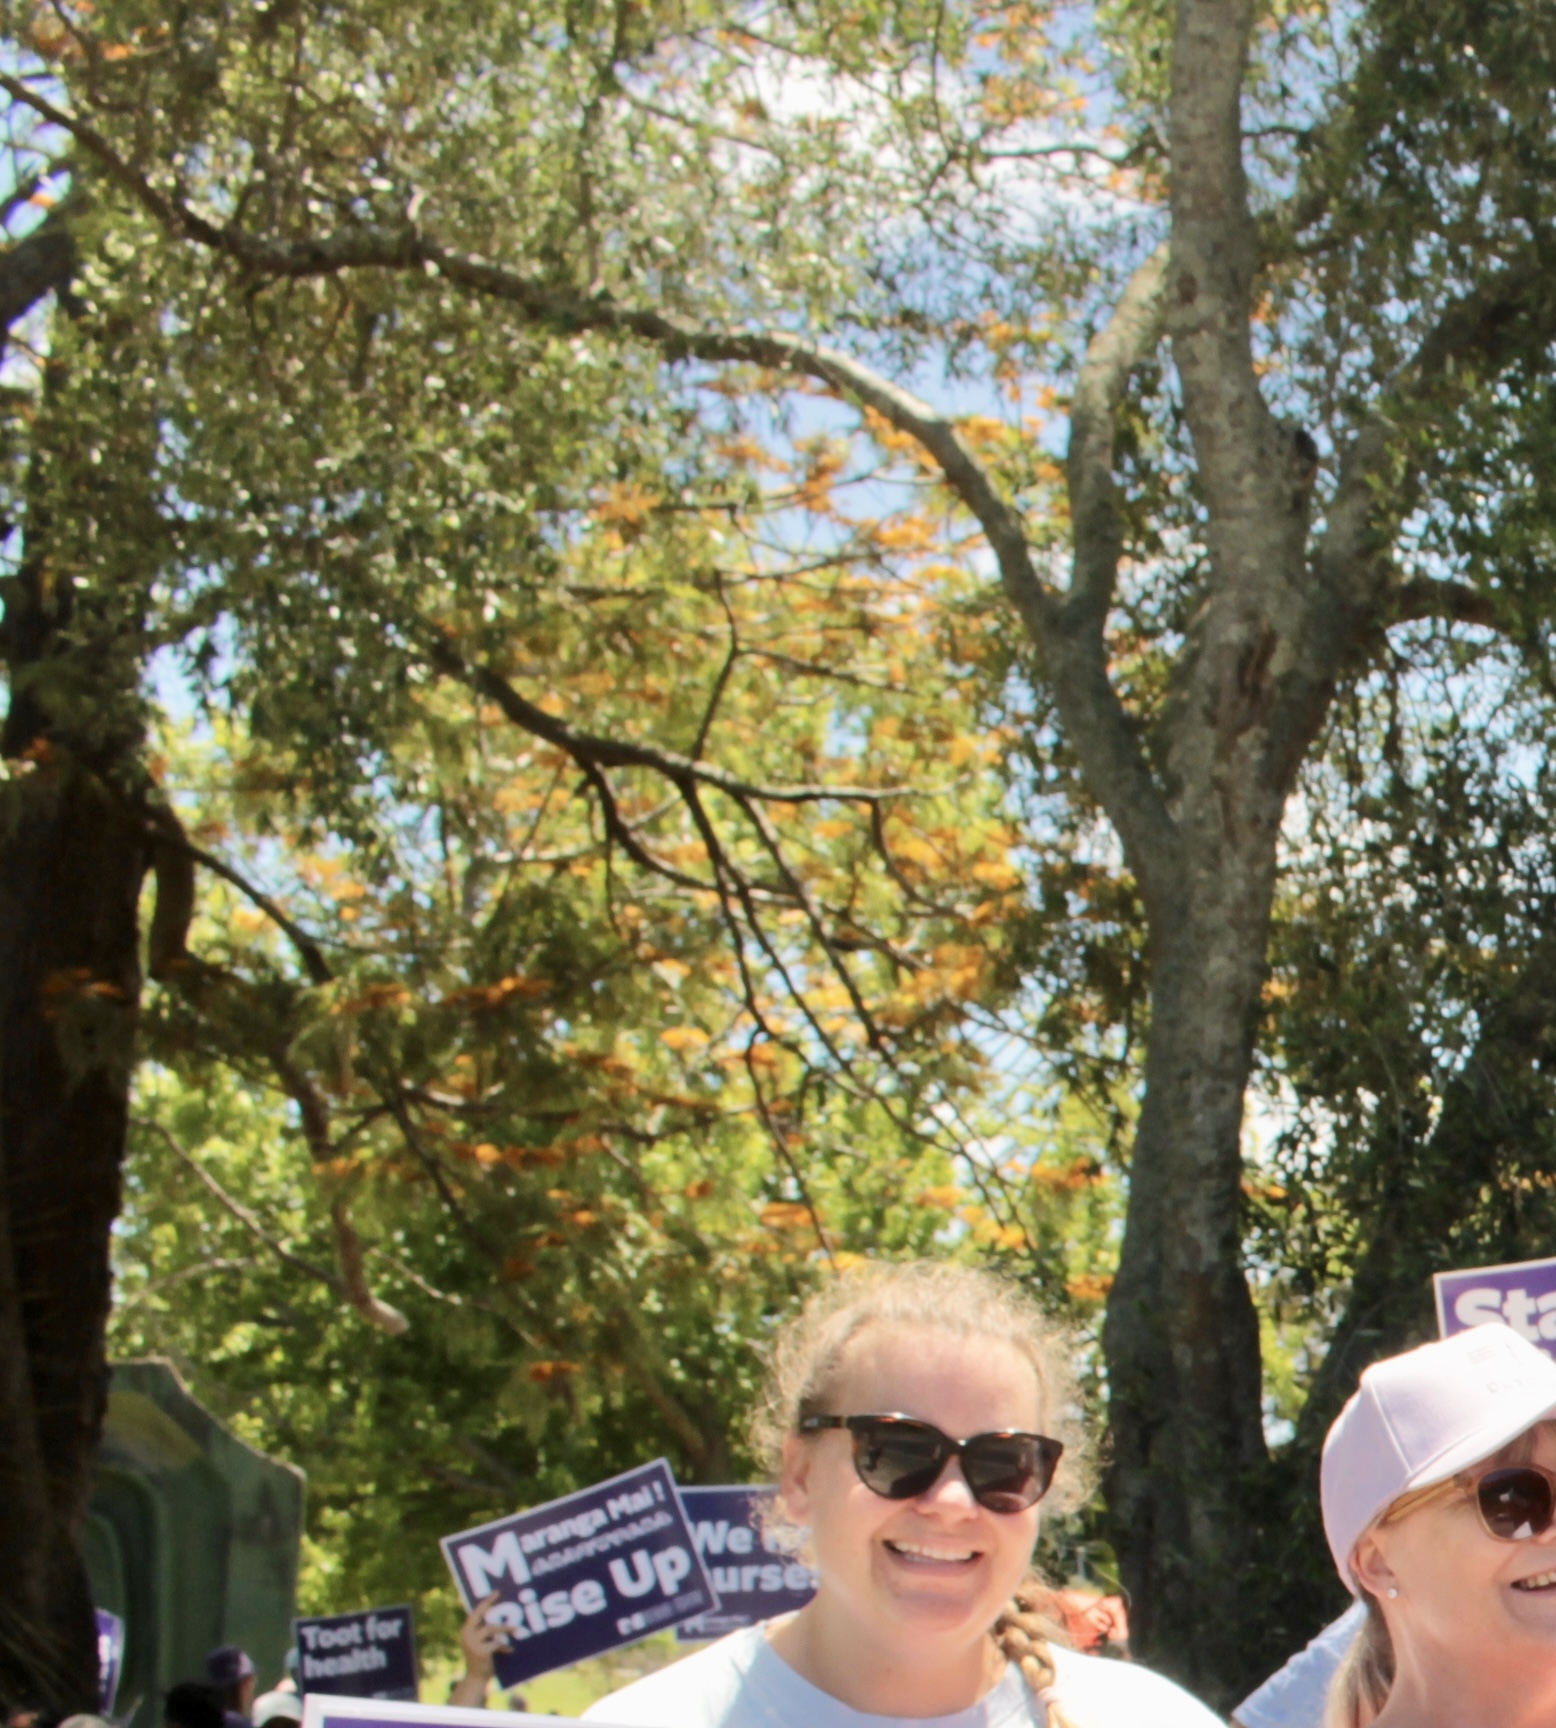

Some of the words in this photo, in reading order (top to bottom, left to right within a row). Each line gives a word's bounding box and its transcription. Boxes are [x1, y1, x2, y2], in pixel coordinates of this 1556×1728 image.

[695, 1520, 753, 1555] We
[484, 1578, 608, 1643] Rise
[608, 1545, 692, 1597] Up
[709, 1563, 820, 1593] urse
[301, 1623, 363, 1650] Toot
[366, 1615, 403, 1640] for
[304, 1646, 387, 1679] health
